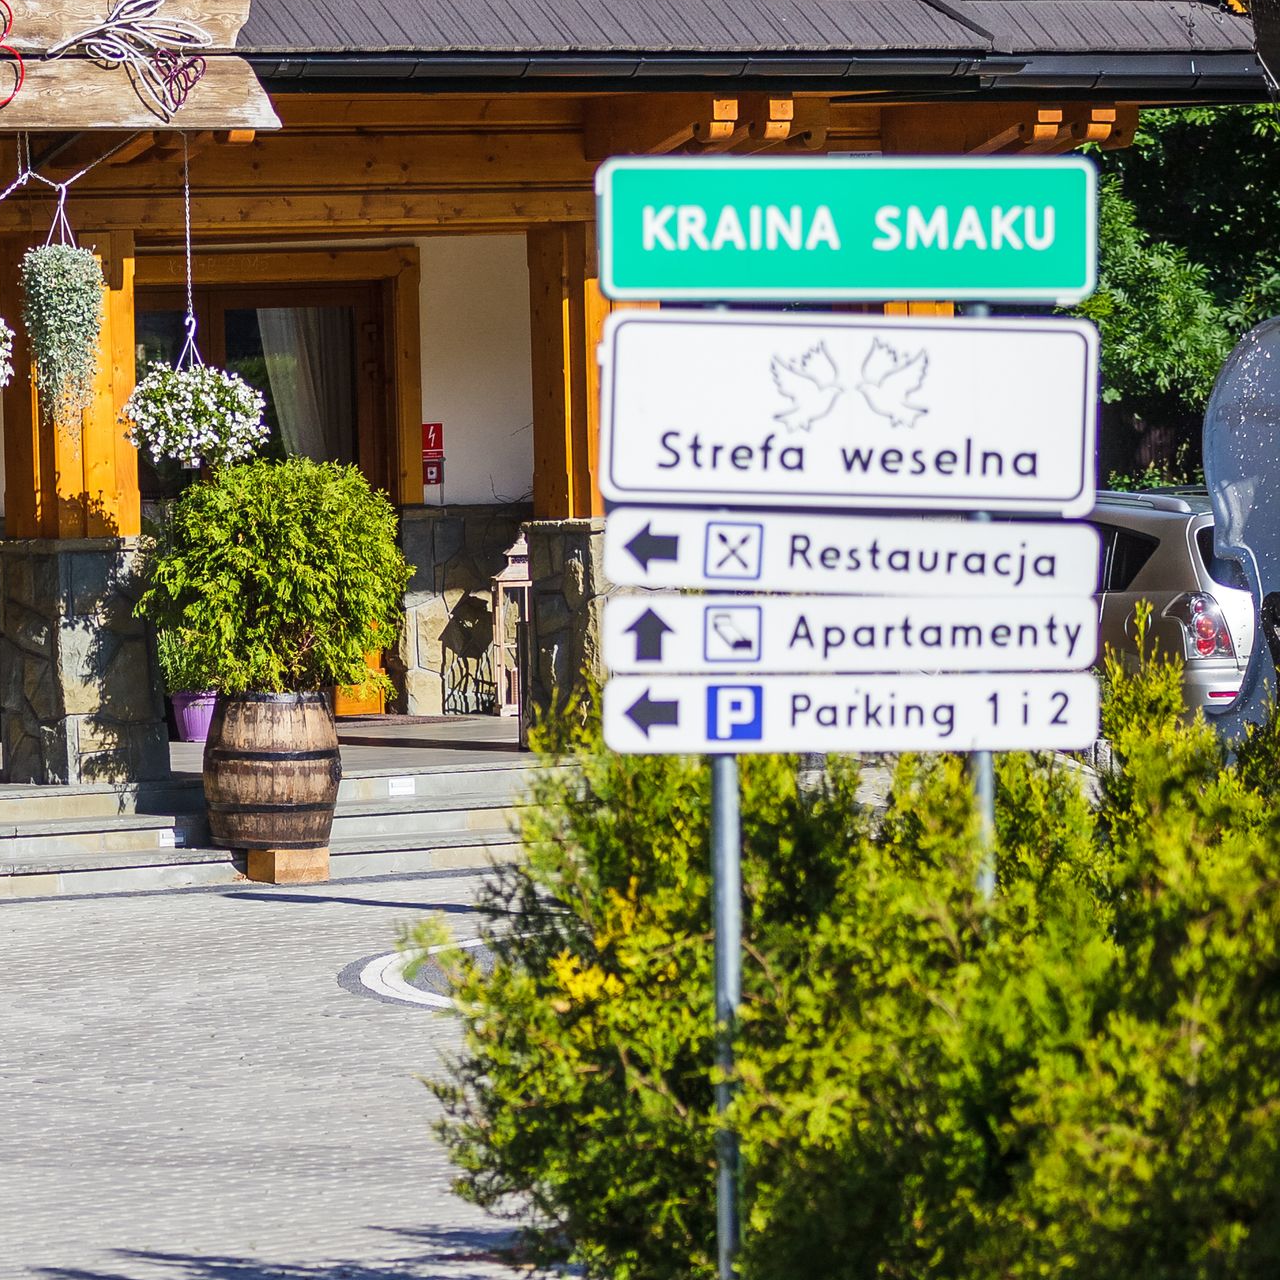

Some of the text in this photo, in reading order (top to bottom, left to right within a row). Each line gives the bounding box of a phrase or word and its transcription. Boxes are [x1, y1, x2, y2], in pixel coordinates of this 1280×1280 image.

[642, 204, 1055, 251] KRAINA SMAKU
[657, 431, 1038, 478] Strefa weselna
[789, 534, 1056, 586] Restauracja
[789, 615, 1082, 659] Apartamenty
[791, 693, 955, 738] Parking
[987, 692, 999, 726] 1
[1022, 691, 1029, 726] i
[1050, 691, 1069, 725] 2
